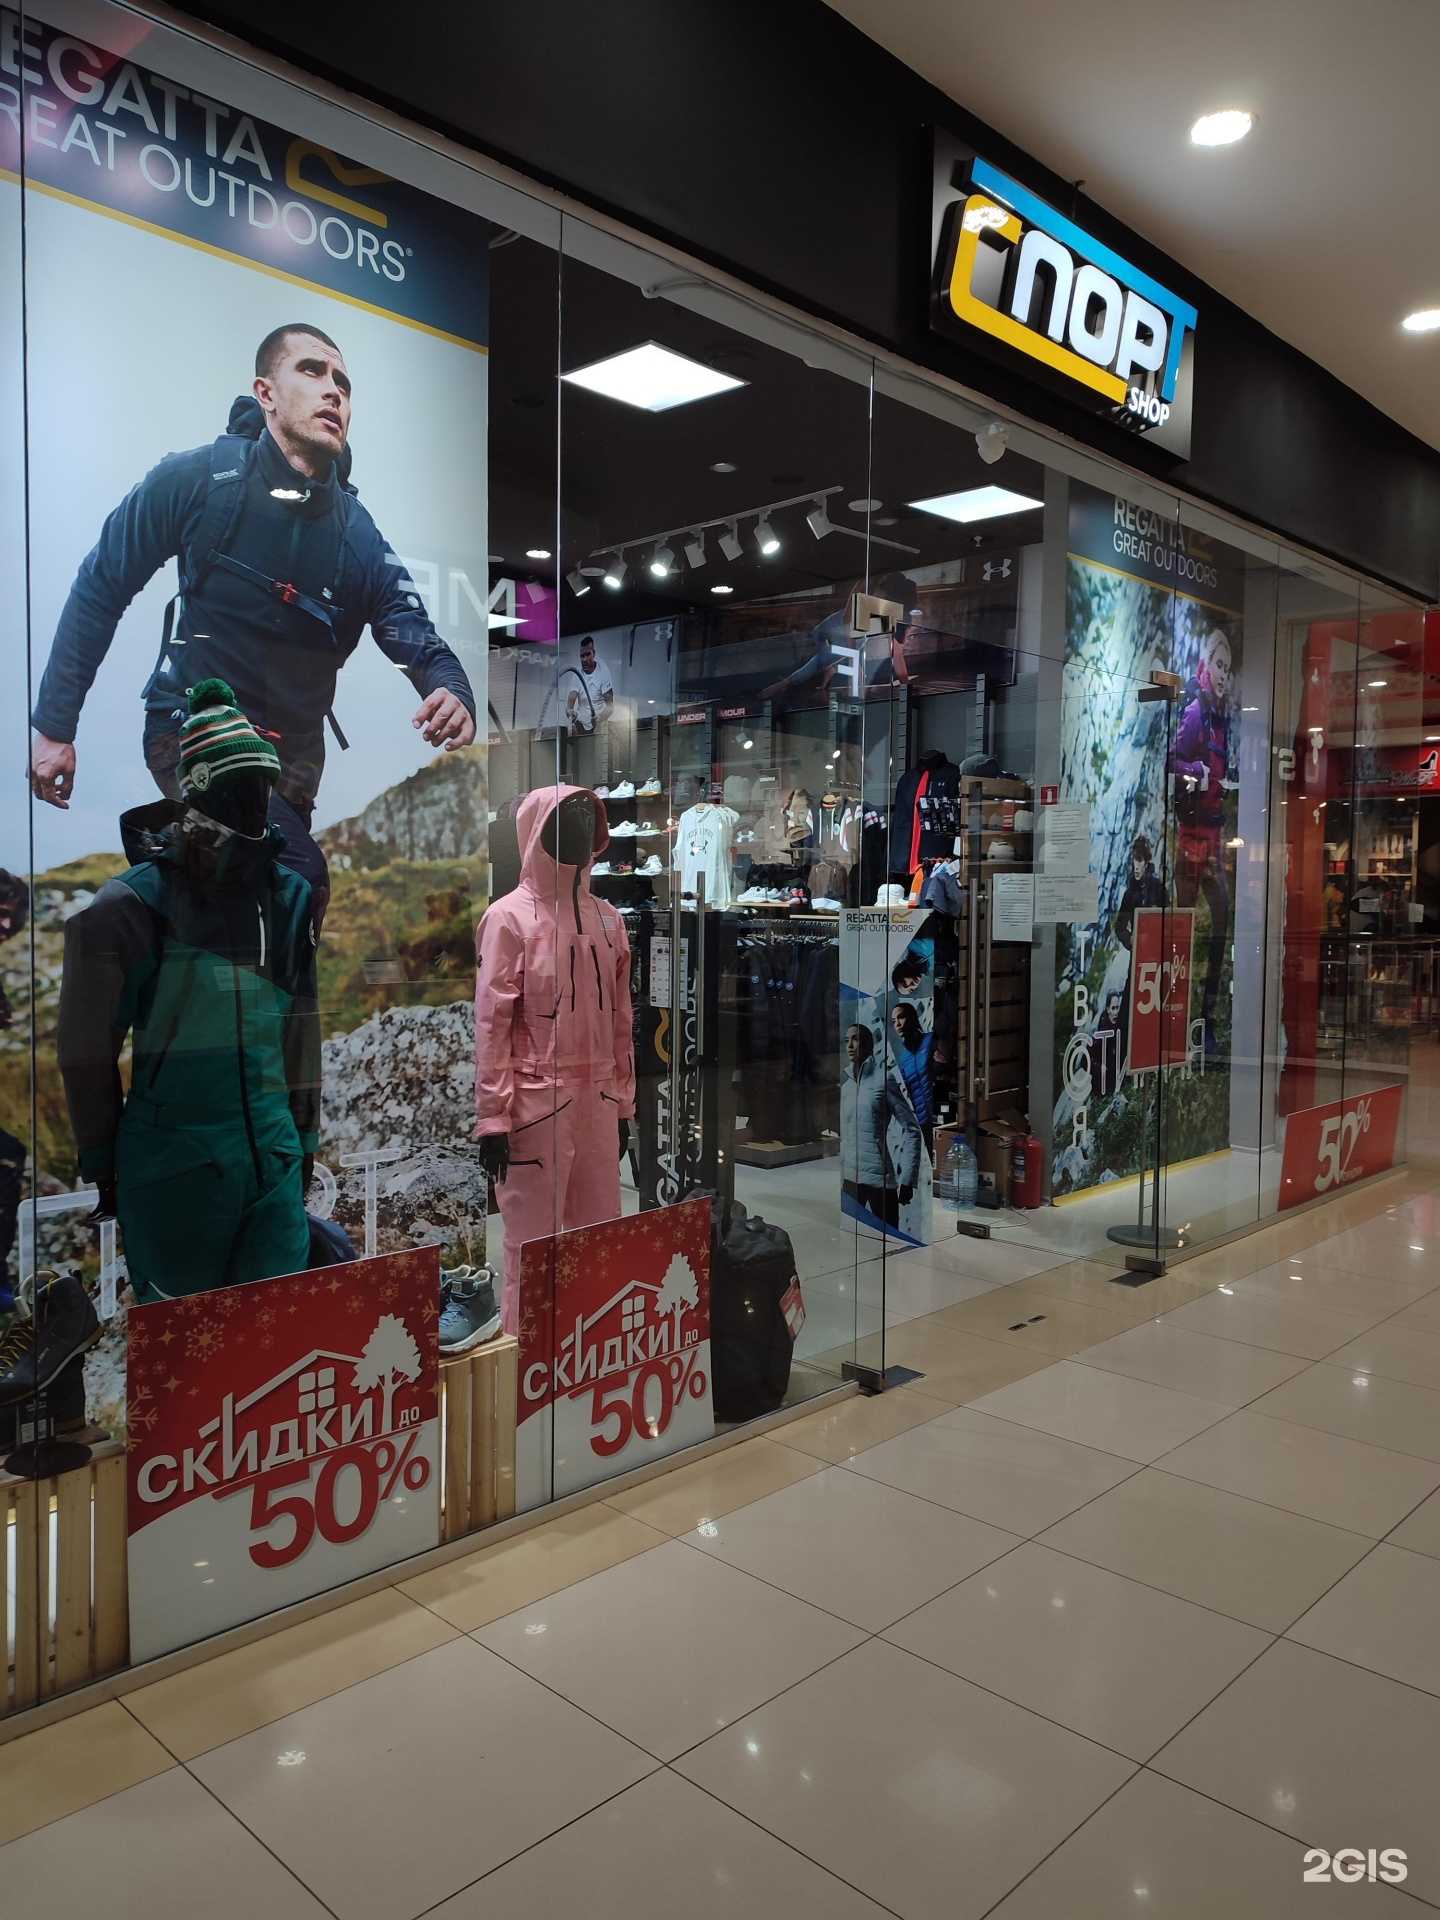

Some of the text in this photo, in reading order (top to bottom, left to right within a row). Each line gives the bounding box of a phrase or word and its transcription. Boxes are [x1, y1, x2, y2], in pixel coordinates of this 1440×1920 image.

[1127, 386, 1170, 426] SHOP
[1113, 529, 1218, 588] GREAT OUTDOORS
[846, 913, 888, 923] REGATTA
[846, 924, 914, 933] GREAT OUTDOORS
[567, 1348, 708, 1458] 50%
[212, 1430, 431, 1569] 50%
